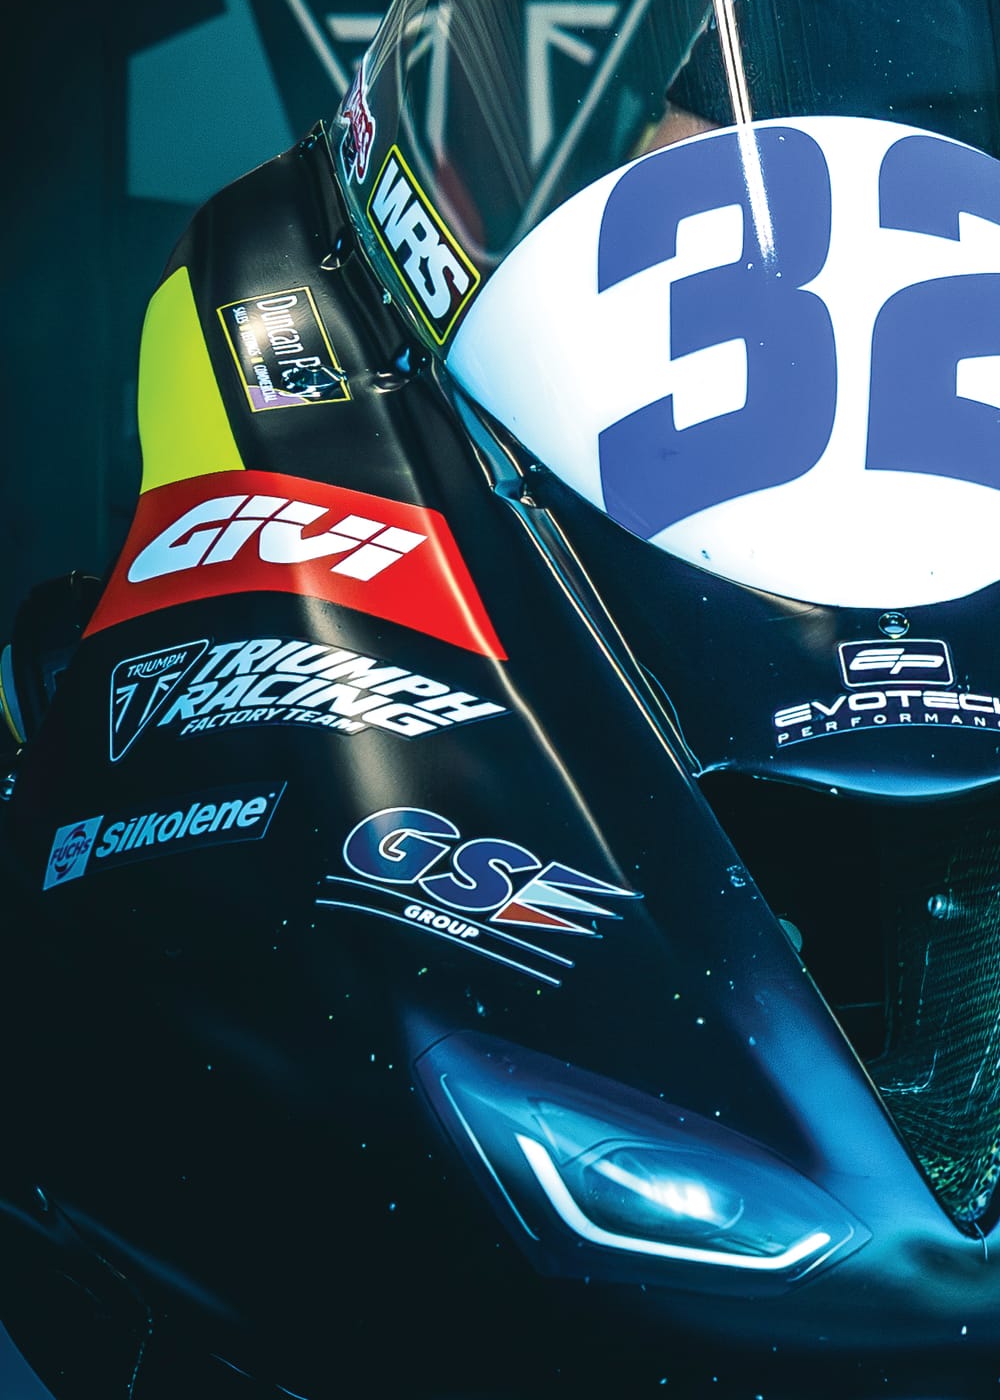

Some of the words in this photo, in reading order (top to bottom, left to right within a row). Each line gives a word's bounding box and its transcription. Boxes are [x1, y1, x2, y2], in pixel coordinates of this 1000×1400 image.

[371, 157, 470, 319] WRS
[232, 306, 249, 325] SALES
[253, 364, 279, 403] COMMERCIAL
[256, 295, 304, 356] Duncan
[127, 494, 428, 583] GIVI
[127, 650, 188, 679] TRIUMPH
[192, 638, 506, 725] TRIUMPH
[157, 674, 438, 737] RACING
[180, 705, 278, 736] FACTORY
[281, 707, 365, 733] TEAM
[51, 837, 92, 865] FUCHS
[95, 795, 268, 858] Silkolene
[402, 904, 480, 940] GROUP
